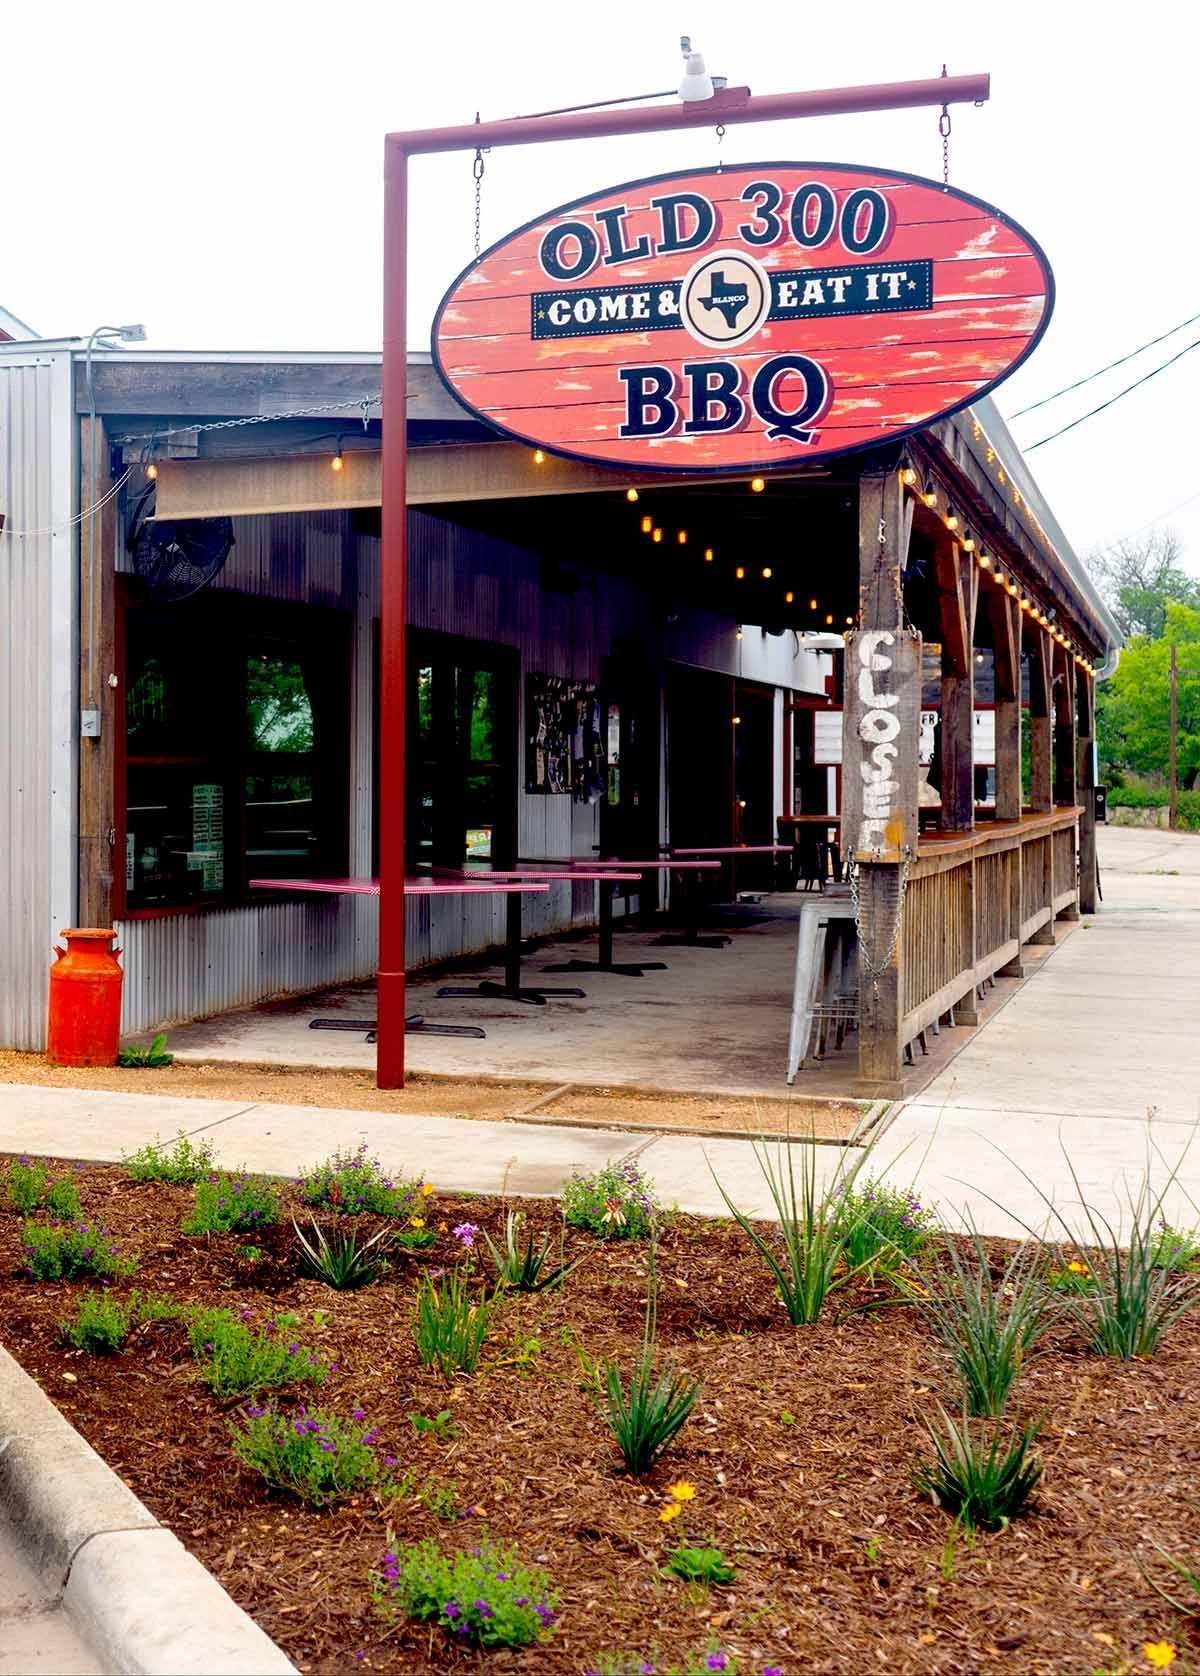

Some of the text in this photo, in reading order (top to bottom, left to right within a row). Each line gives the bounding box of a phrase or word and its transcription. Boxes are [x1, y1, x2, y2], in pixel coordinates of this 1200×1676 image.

[539, 181, 889, 281] OLD 300
[547, 272, 907, 325] COME & EAT IT
[712, 295, 746, 304] BLANCO
[618, 354, 829, 445] BBQ
